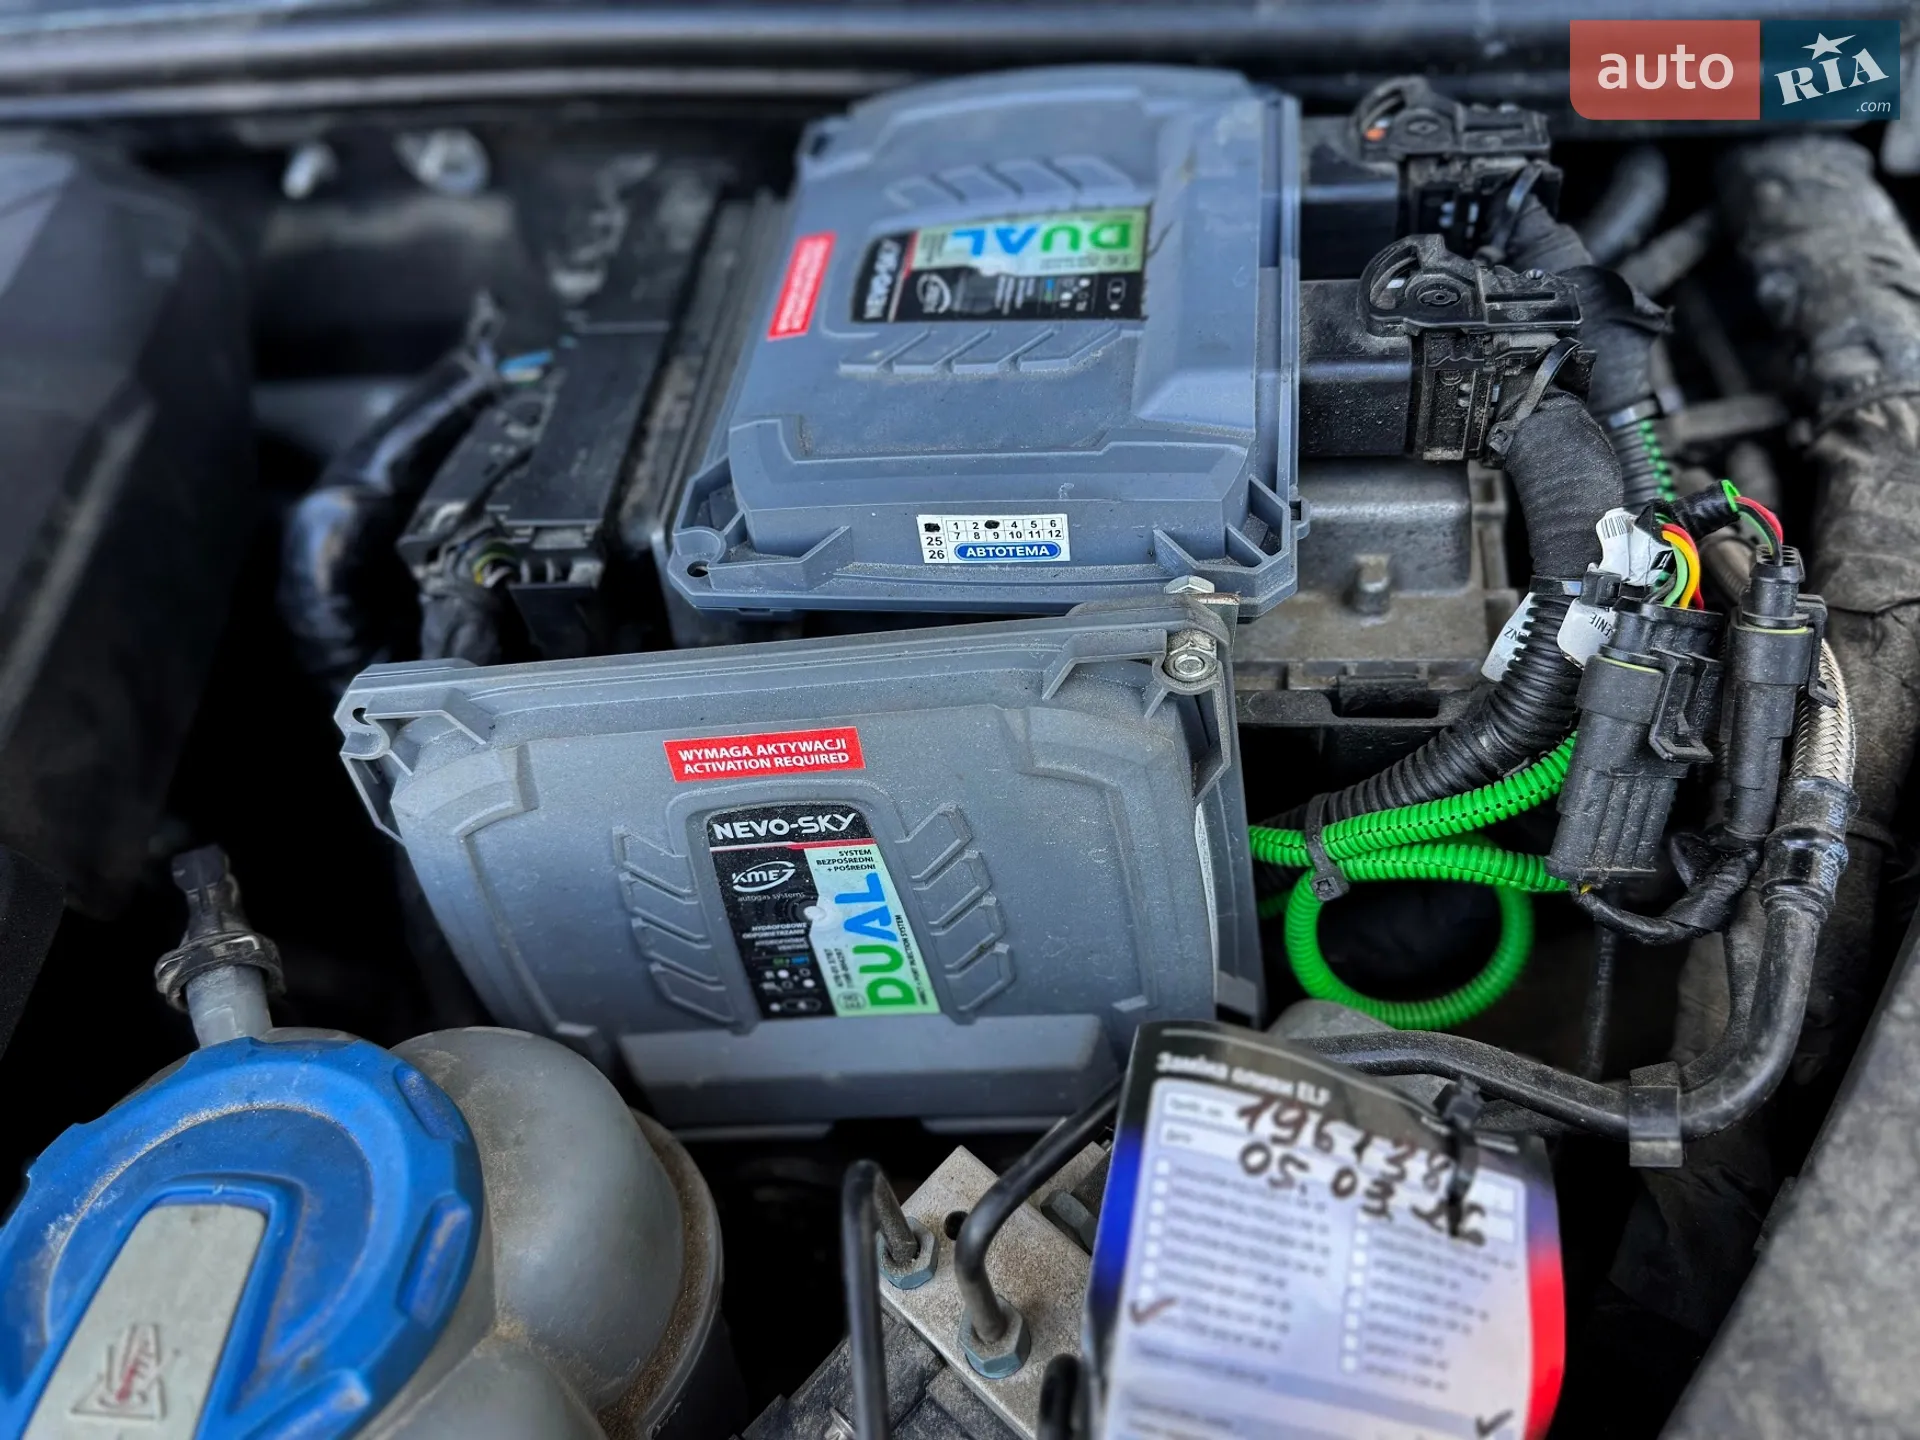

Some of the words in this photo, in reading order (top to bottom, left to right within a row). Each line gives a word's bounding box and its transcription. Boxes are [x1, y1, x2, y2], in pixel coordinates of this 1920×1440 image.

[952, 220, 1132, 256] DUAL
[973, 522, 979, 530] 2
[1011, 521, 1018, 529] 4
[1031, 521, 1037, 529] 5
[1050, 520, 1056, 528] 6
[955, 532, 960, 540] 7
[974, 532, 980, 540] 8
[993, 532, 999, 540] 9
[1048, 530, 1061, 538] 12
[926, 537, 943, 546] 25
[929, 550, 945, 559] 26
[966, 545, 1050, 557] АВТОТЕМА
[678, 746, 752, 761] WYMAGA
[756, 738, 847, 755] AKTYWACJI
[684, 757, 772, 774] ACTIVATION
[775, 752, 849, 768] REQUIRED
[713, 813, 856, 840] NEVO-SKY
[838, 849, 872, 857] SYSTEM
[816, 856, 874, 866] BEZPOŚREDNI
[834, 862, 876, 872] POŚREDNI
[895, 914, 907, 937] SYSTEM
[835, 872, 917, 1006] DUAL
